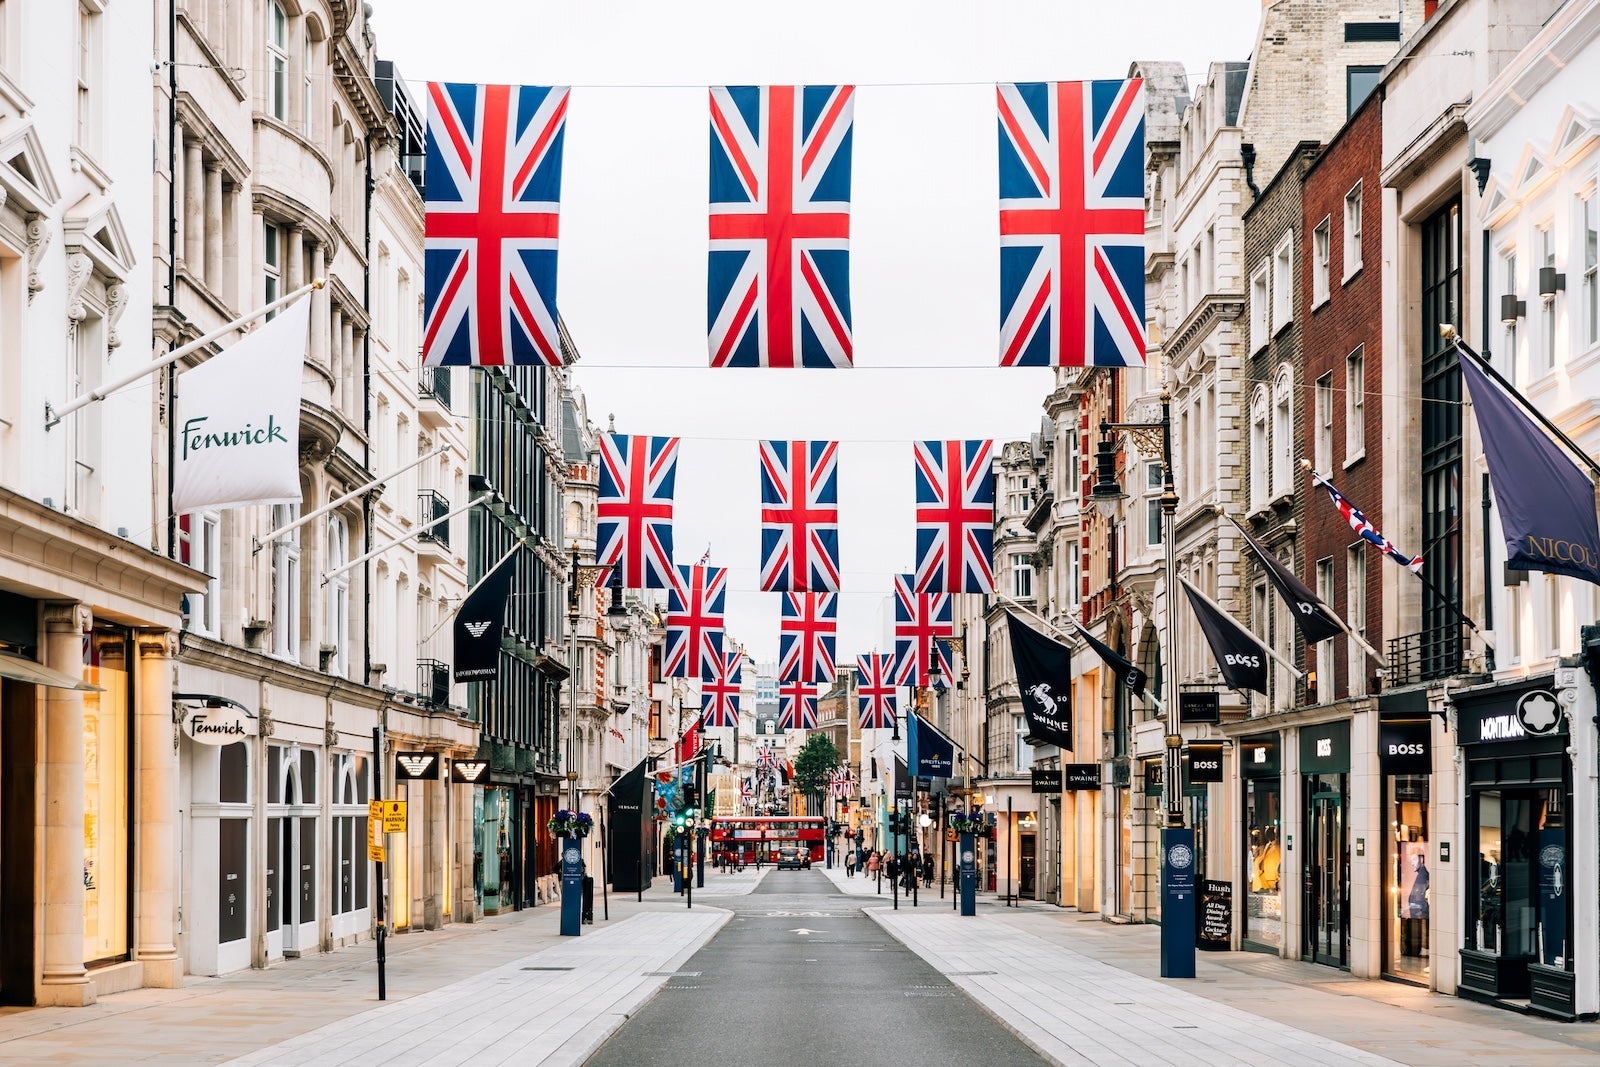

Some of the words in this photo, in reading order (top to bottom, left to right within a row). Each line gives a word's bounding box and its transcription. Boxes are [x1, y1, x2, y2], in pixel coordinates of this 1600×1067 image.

[181, 414, 288, 461] Fenwick
[1224, 653, 1260, 668] BOSS
[190, 714, 246, 737] Fenwick
[1388, 744, 1425, 756] BOSS
[1193, 761, 1218, 770] BOSS
[1208, 883, 1231, 893] Hush
[1215, 903, 1226, 911] Day
